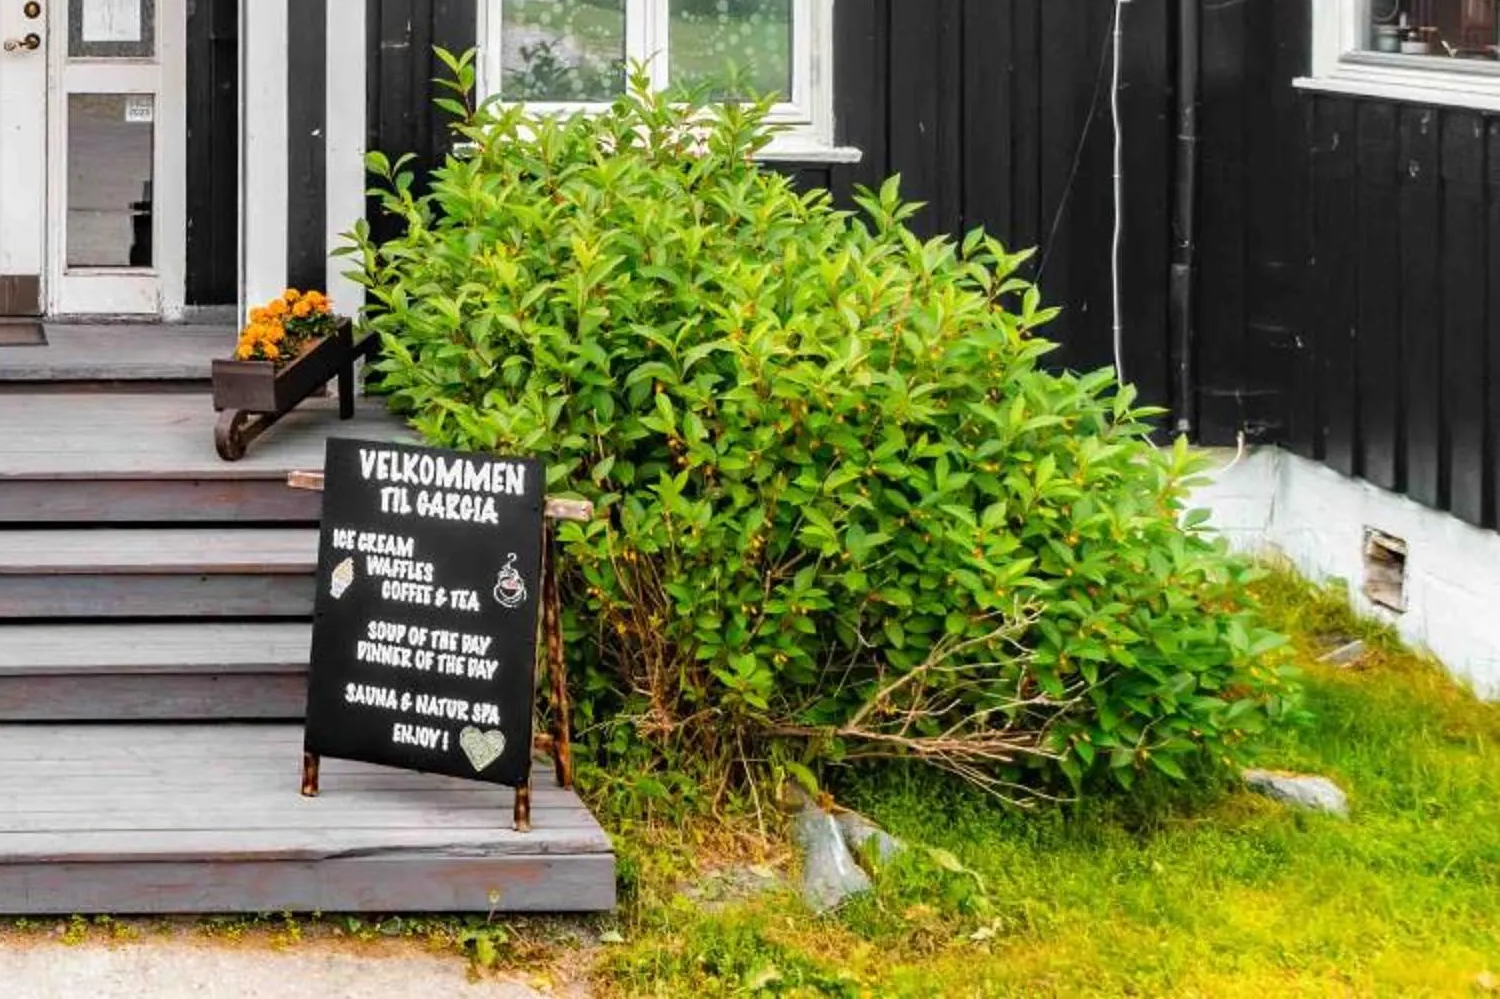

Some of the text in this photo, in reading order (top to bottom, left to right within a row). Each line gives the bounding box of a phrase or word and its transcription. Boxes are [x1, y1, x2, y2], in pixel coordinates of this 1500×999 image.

[359, 449, 526, 495] VELKOMMEN
[380, 487, 499, 524] TIL GARGIA
[332, 528, 415, 558] ICE CREAM
[366, 555, 435, 582] WAFFLES
[381, 581, 480, 612] COFFEE & TEA
[367, 620, 492, 656] SOUP OF THE DAY
[357, 640, 499, 680] DINNER OF THE DAY
[344, 683, 500, 725] SAUNA & NATUR SPA
[392, 723, 441, 750] ENJOY
